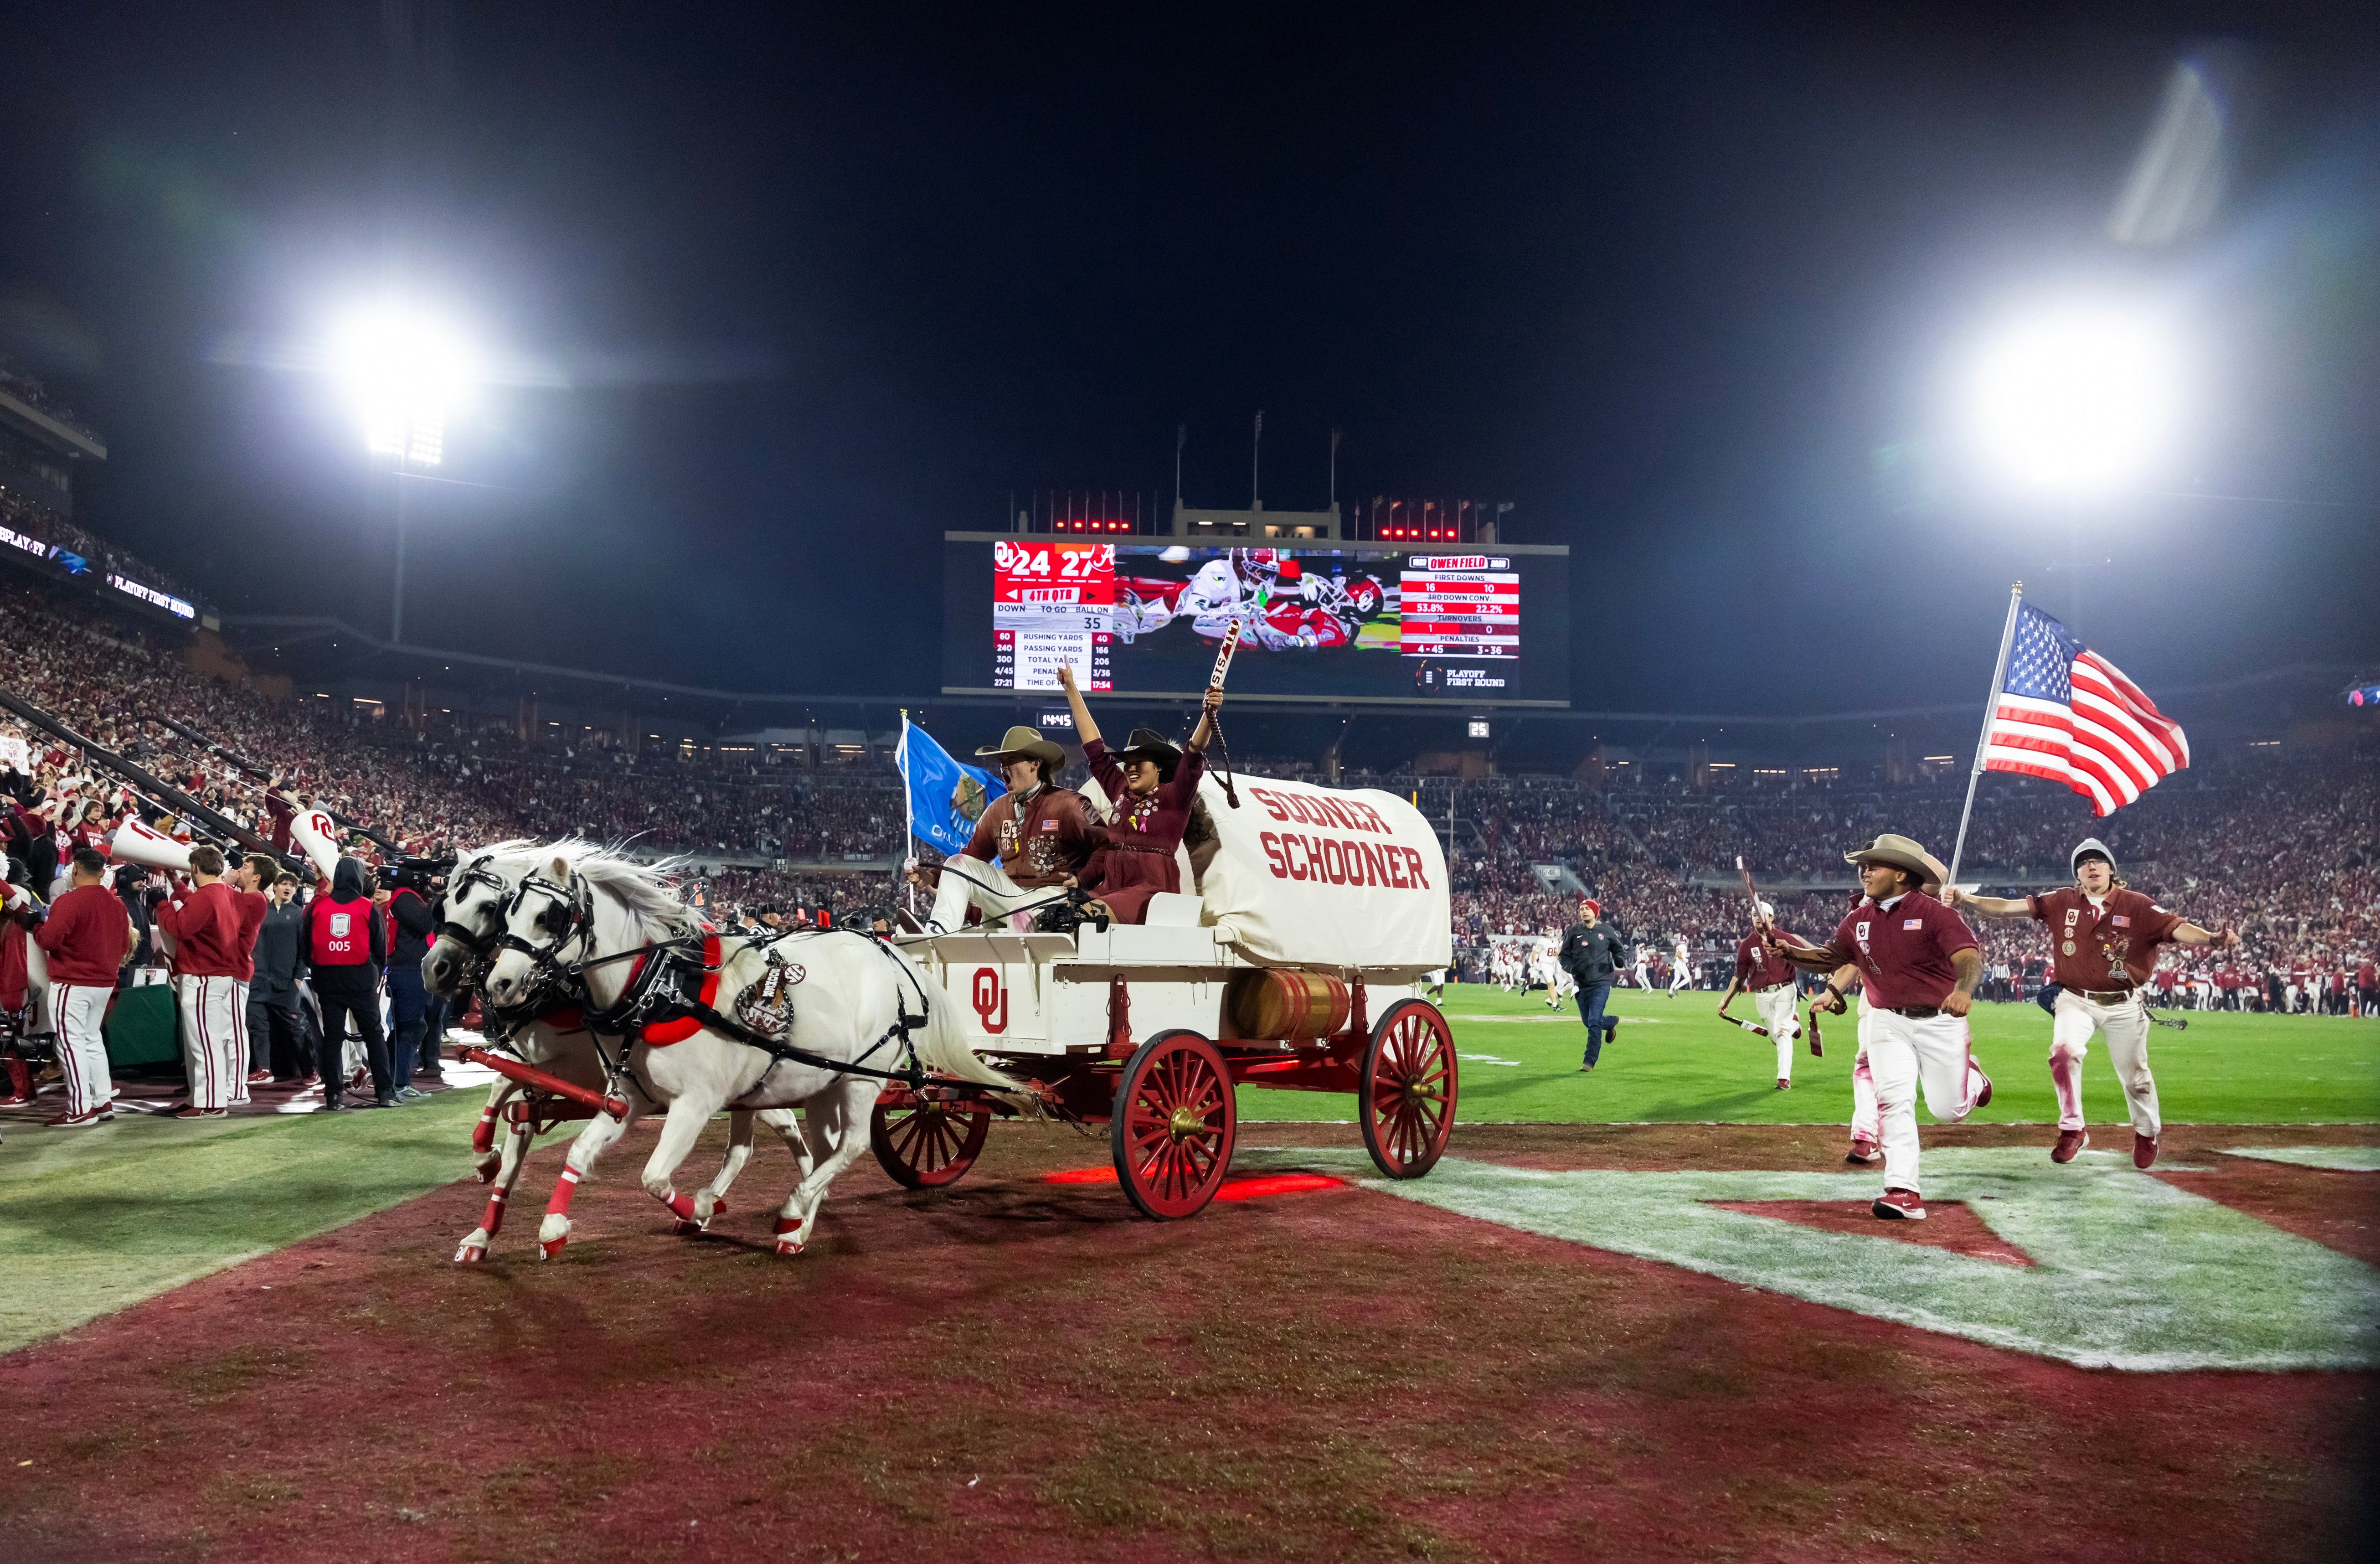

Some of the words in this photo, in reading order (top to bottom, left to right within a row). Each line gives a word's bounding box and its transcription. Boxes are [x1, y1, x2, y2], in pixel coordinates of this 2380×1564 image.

[994, 542, 1013, 568] OU
[1012, 550, 1051, 576] 24
[1061, 551, 1092, 577] 27
[1431, 558, 1458, 568] OWEN
[1460, 557, 1485, 568] FIELD
[1425, 583, 1436, 592] 16
[1484, 584, 1494, 593] 10
[114, 575, 149, 600] PLAYOFF
[148, 589, 170, 609] FIRST
[170, 599, 194, 619] ROUND
[1029, 589, 1049, 602] 4TH
[1051, 589, 1072, 602] QTR
[1417, 603, 1444, 613] 53.8%
[1476, 604, 1503, 614] 22.2%
[1084, 618, 1100, 629] 35
[1428, 624, 1432, 632] 1
[1486, 625, 1493, 634] 0
[1211, 658, 1226, 685] SIS
[1447, 670, 1486, 678] PLAYOFF
[1447, 678, 1473, 686] FIRST
[1043, 714, 1072, 727] 14:45
[1471, 723, 1487, 736] 25
[1249, 787, 1393, 834] SOONER
[1003, 822, 1010, 834] OU
[1259, 831, 1430, 890] SCHOONER
[2068, 911, 2076, 923] OU
[1859, 925, 1865, 937] OU
[329, 941, 350, 951] 005
[784, 964, 804, 983] SEC
[973, 967, 1008, 1034] OU
